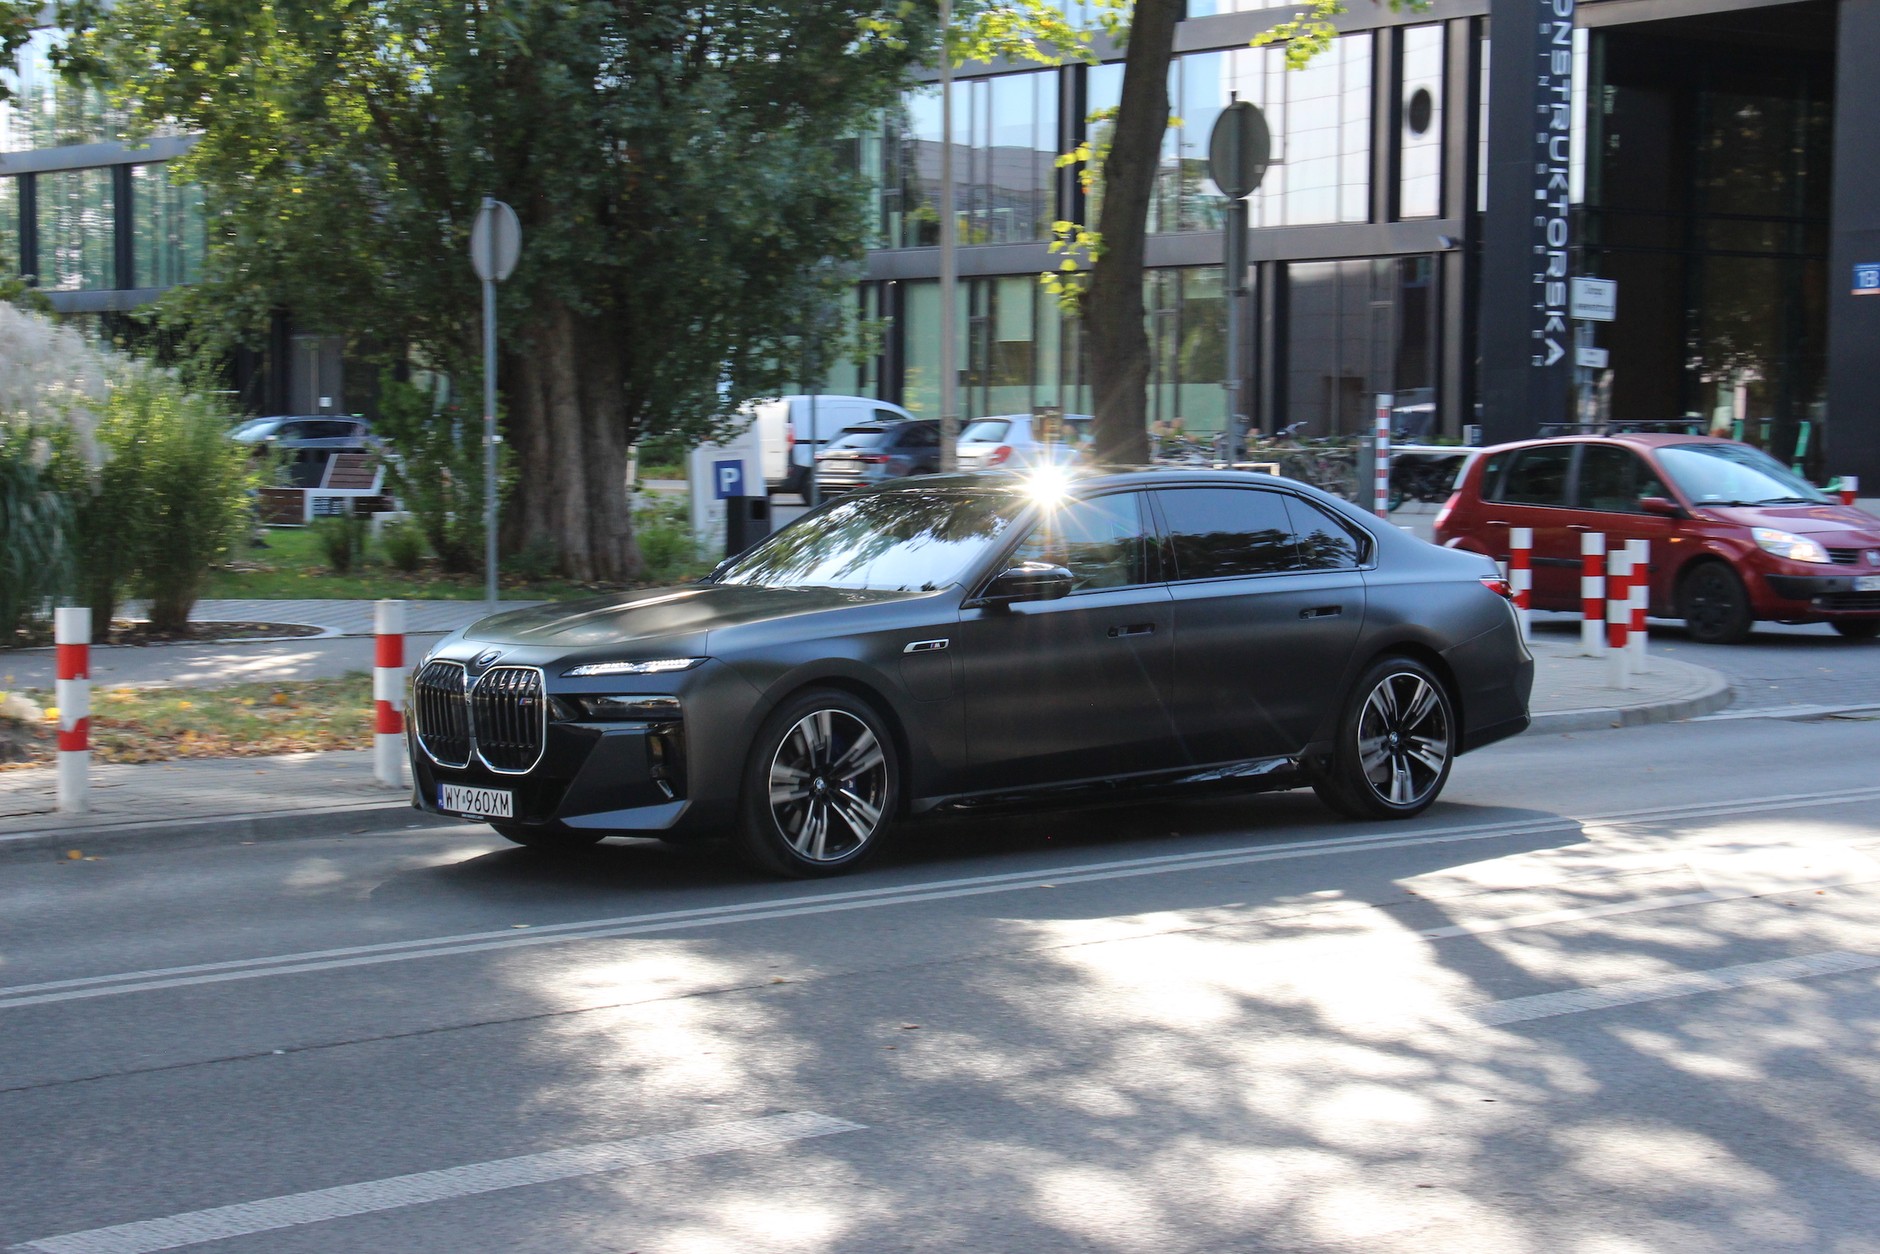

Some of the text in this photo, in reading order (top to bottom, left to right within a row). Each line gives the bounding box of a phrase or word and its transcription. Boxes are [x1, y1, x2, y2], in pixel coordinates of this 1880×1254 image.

[720, 467, 740, 492] P
[445, 787, 460, 809] WY
[466, 789, 509, 815] 960XM
